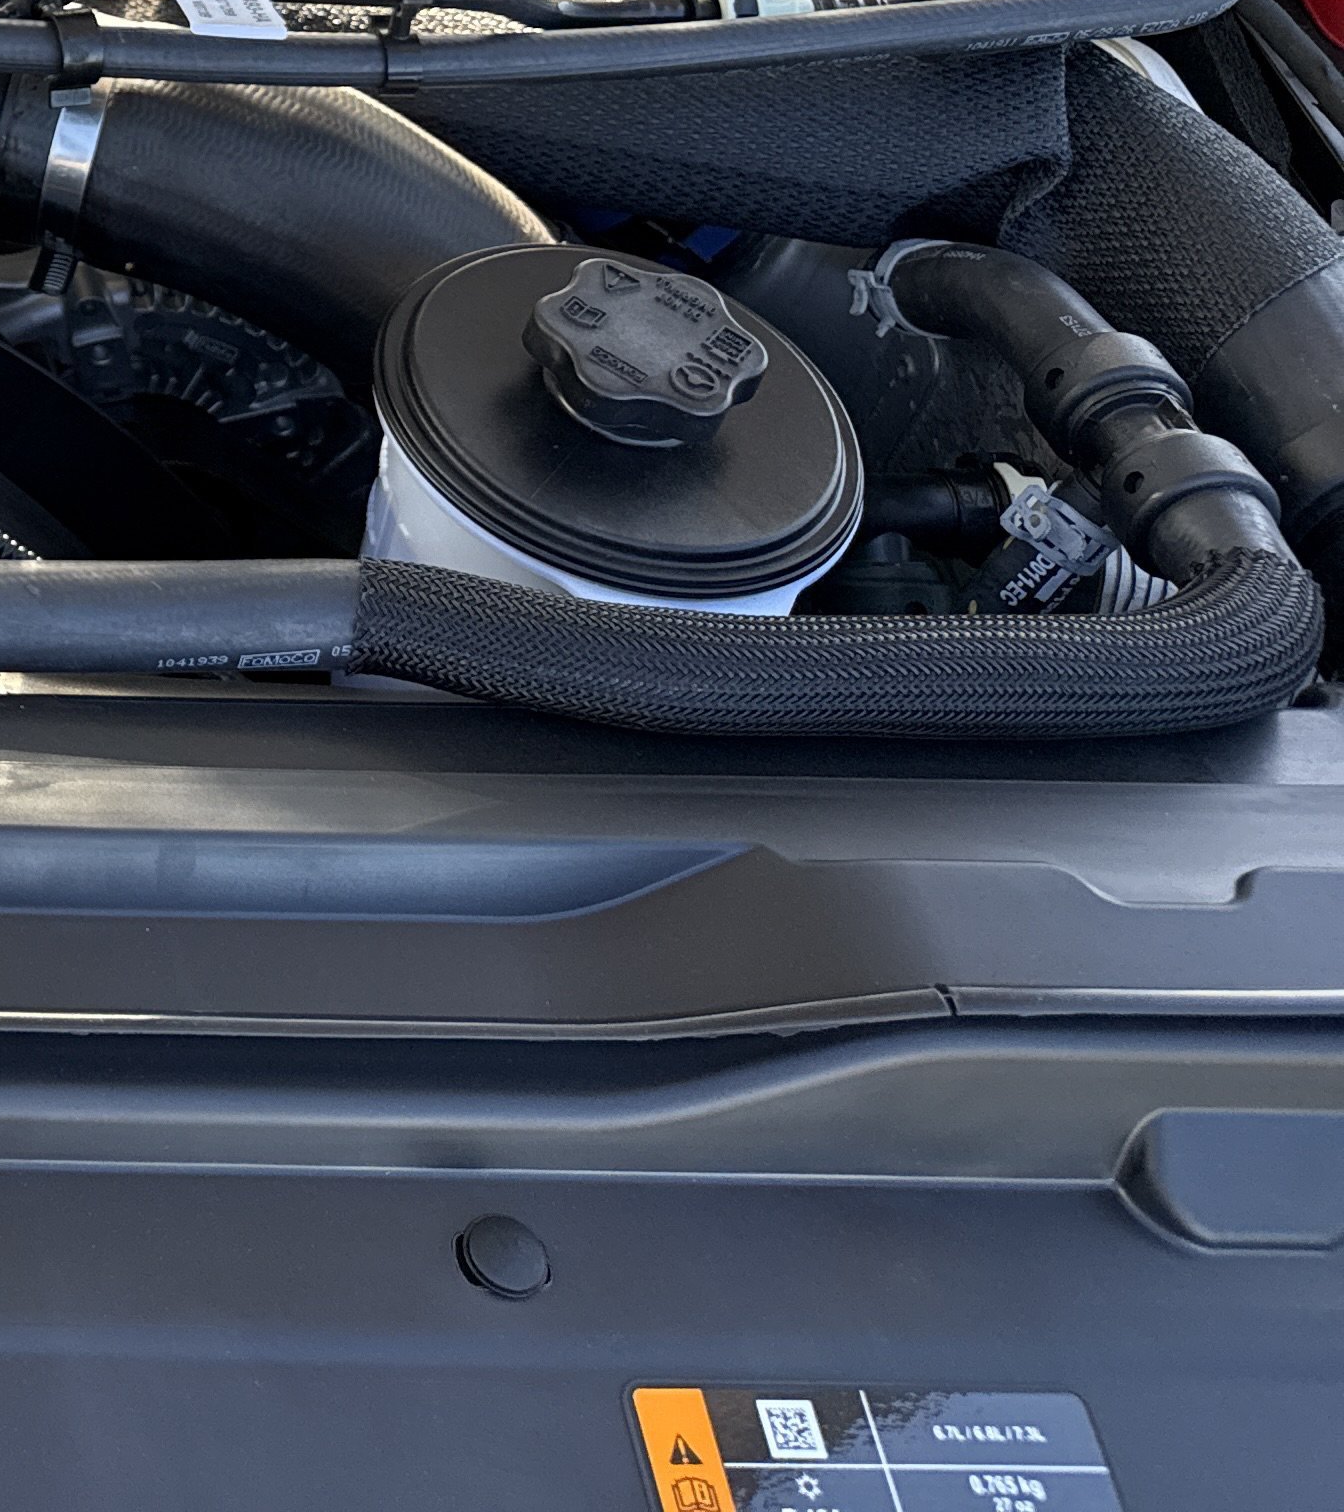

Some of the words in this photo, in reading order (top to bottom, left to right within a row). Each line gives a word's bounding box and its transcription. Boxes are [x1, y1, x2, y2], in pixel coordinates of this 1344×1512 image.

[157, 654, 229, 669] 1041939
[240, 650, 318, 669] FoMoCo
[1017, 1475, 1047, 1501] kg
